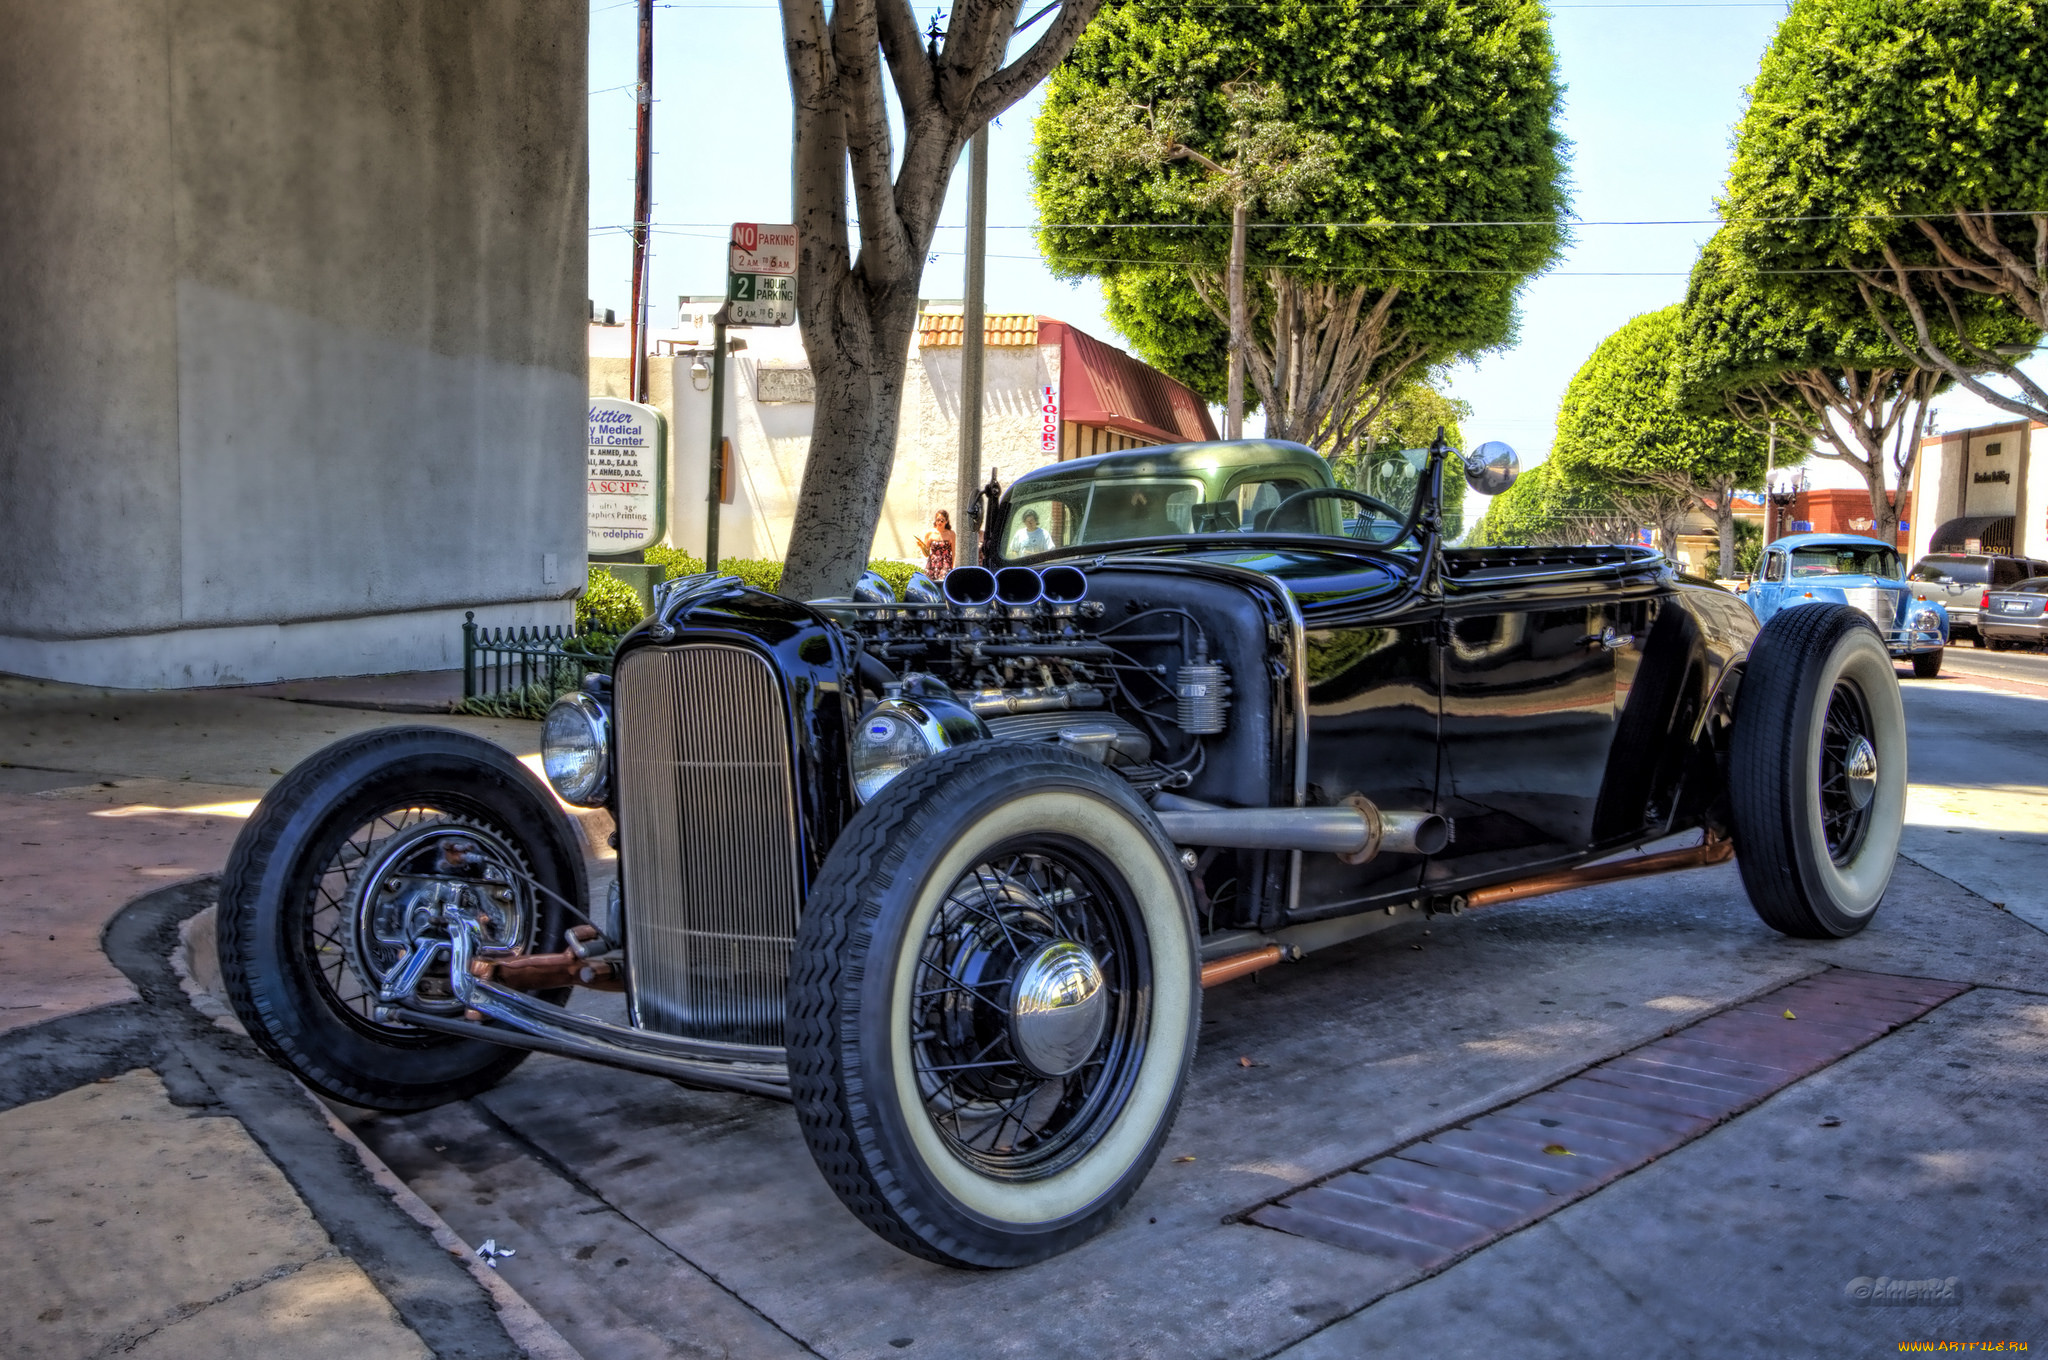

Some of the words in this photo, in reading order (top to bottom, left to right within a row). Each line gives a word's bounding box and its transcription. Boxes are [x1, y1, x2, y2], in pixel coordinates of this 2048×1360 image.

[735, 227, 754, 246] NO
[758, 233, 795, 246] PARKING
[739, 255, 745, 267] 2
[770, 257, 777, 268] 6
[737, 277, 749, 298] 2
[763, 278, 787, 289] HOUR
[756, 290, 793, 301] PARKING
[737, 306, 743, 318] 8
[768, 308, 774, 319] 6
[589, 406, 633, 423] hittier
[1042, 386, 1057, 451] LIQUORS
[599, 425, 641, 435] Medical
[607, 435, 644, 445] Center
[617, 512, 647, 521] Printing
